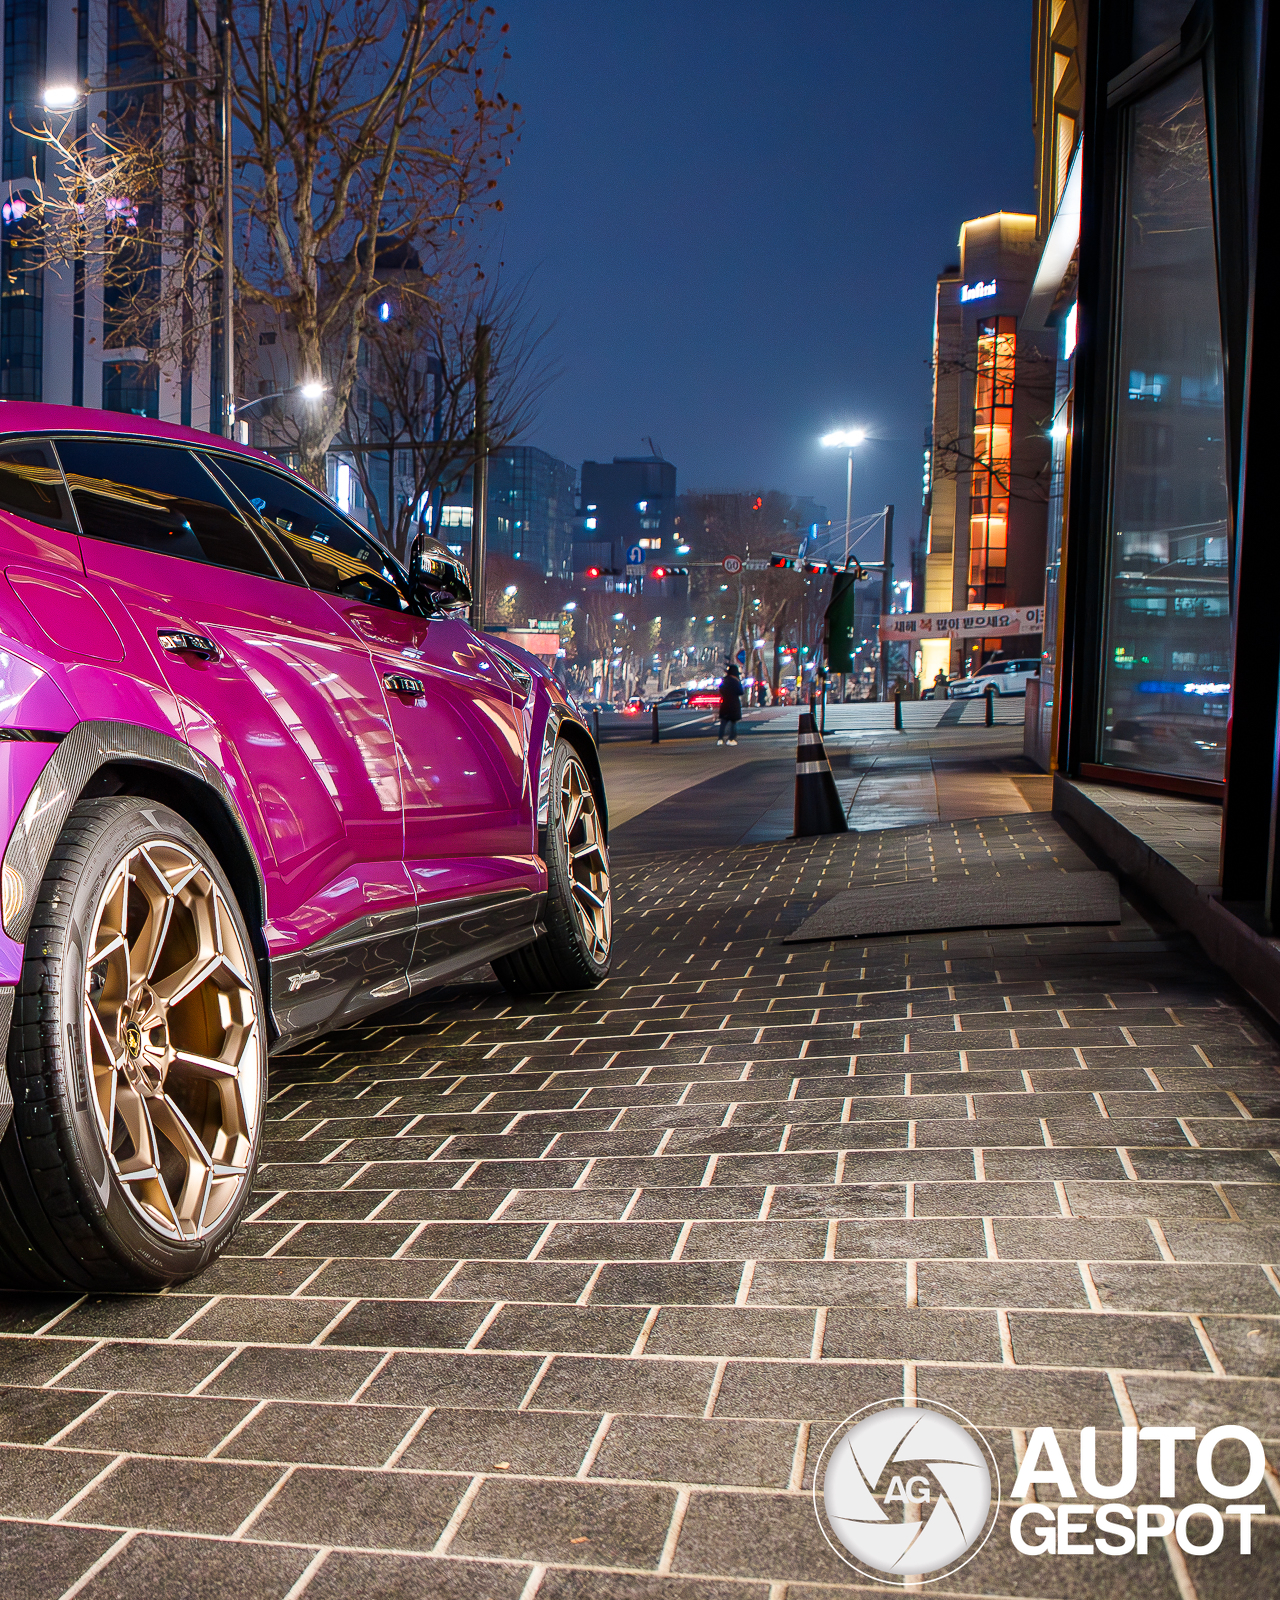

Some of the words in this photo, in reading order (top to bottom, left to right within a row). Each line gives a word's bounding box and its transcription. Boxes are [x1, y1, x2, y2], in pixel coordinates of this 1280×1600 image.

[893, 620, 917, 633] 새해
[920, 618, 932, 632] 복
[936, 617, 960, 631] 많이
